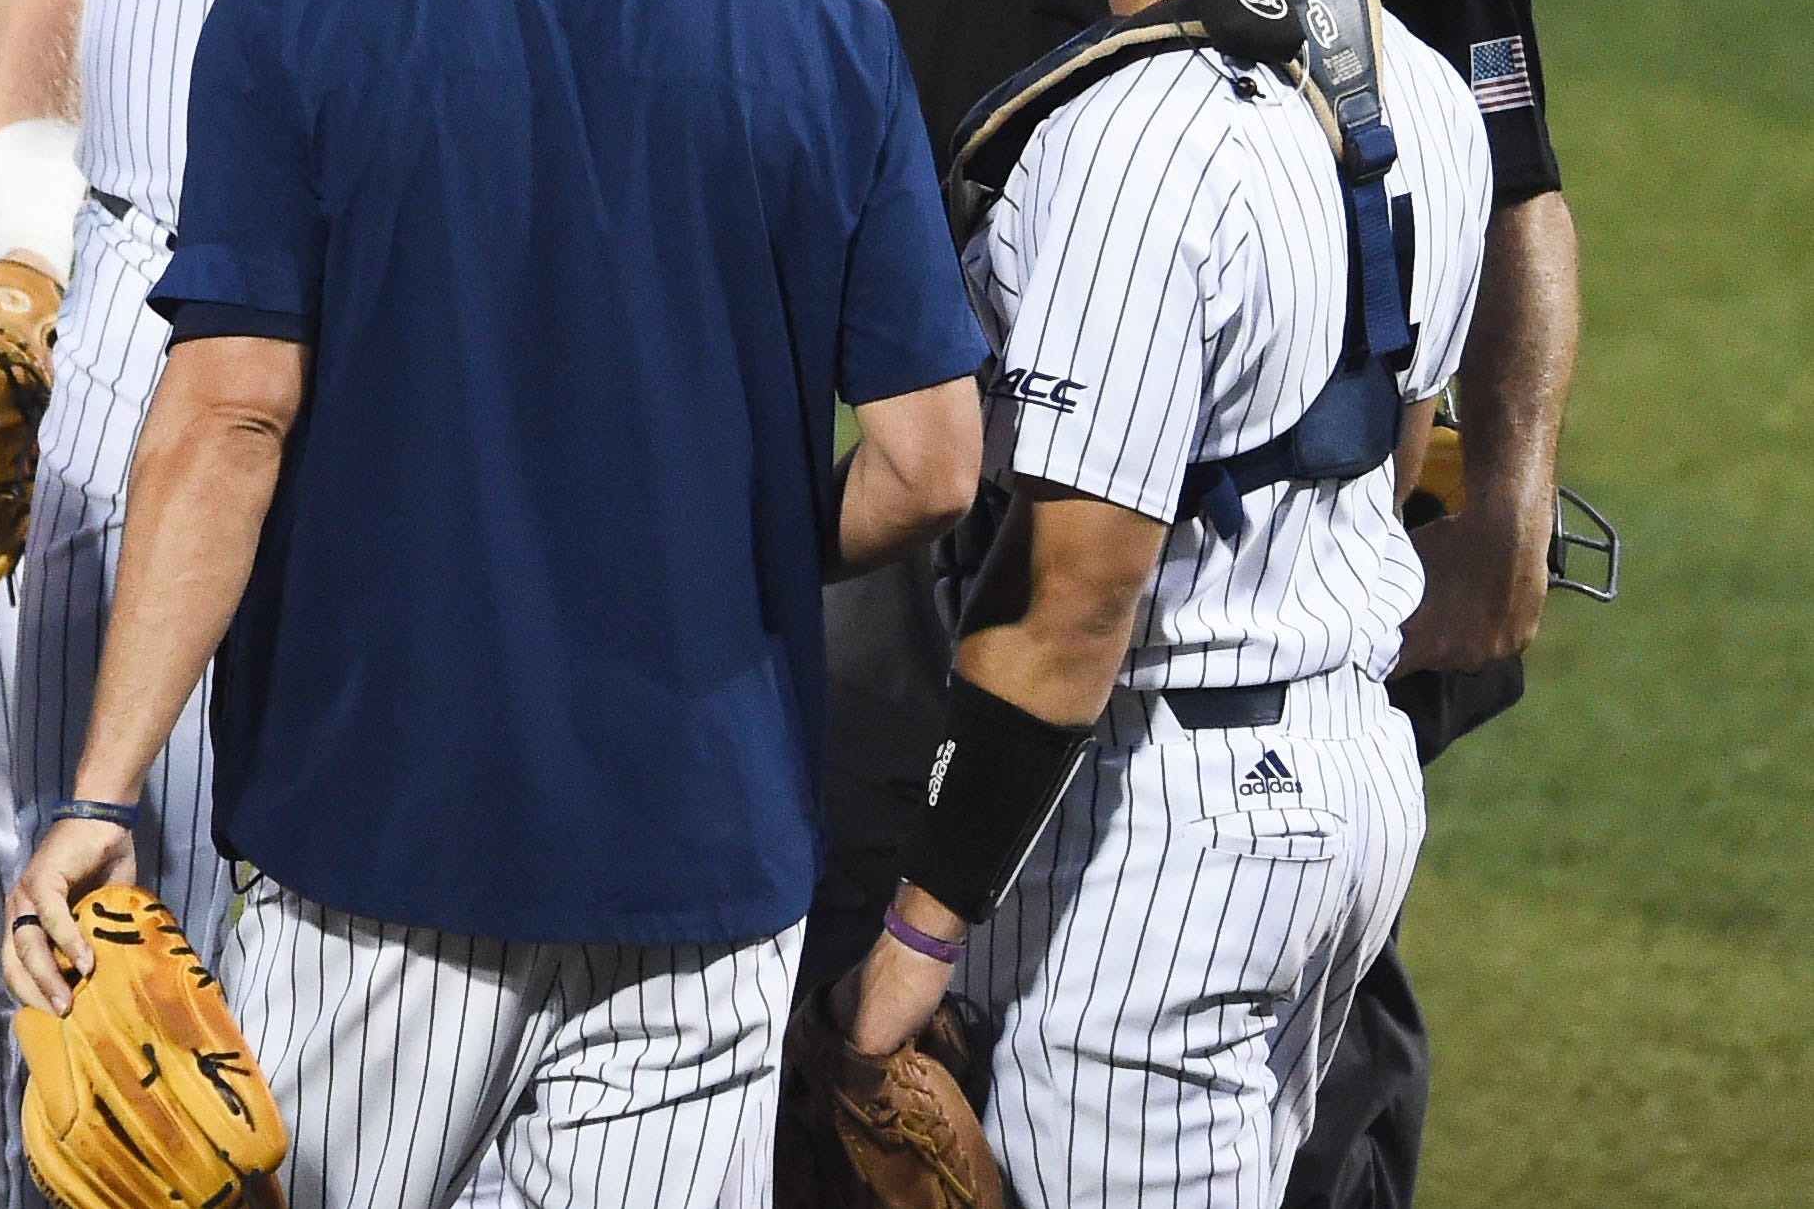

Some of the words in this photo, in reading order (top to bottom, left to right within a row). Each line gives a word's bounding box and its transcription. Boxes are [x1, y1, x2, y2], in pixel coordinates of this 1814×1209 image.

[989, 367, 1089, 408] ACC
[928, 738, 957, 807] adidas
[1238, 777, 1304, 797] adidas
